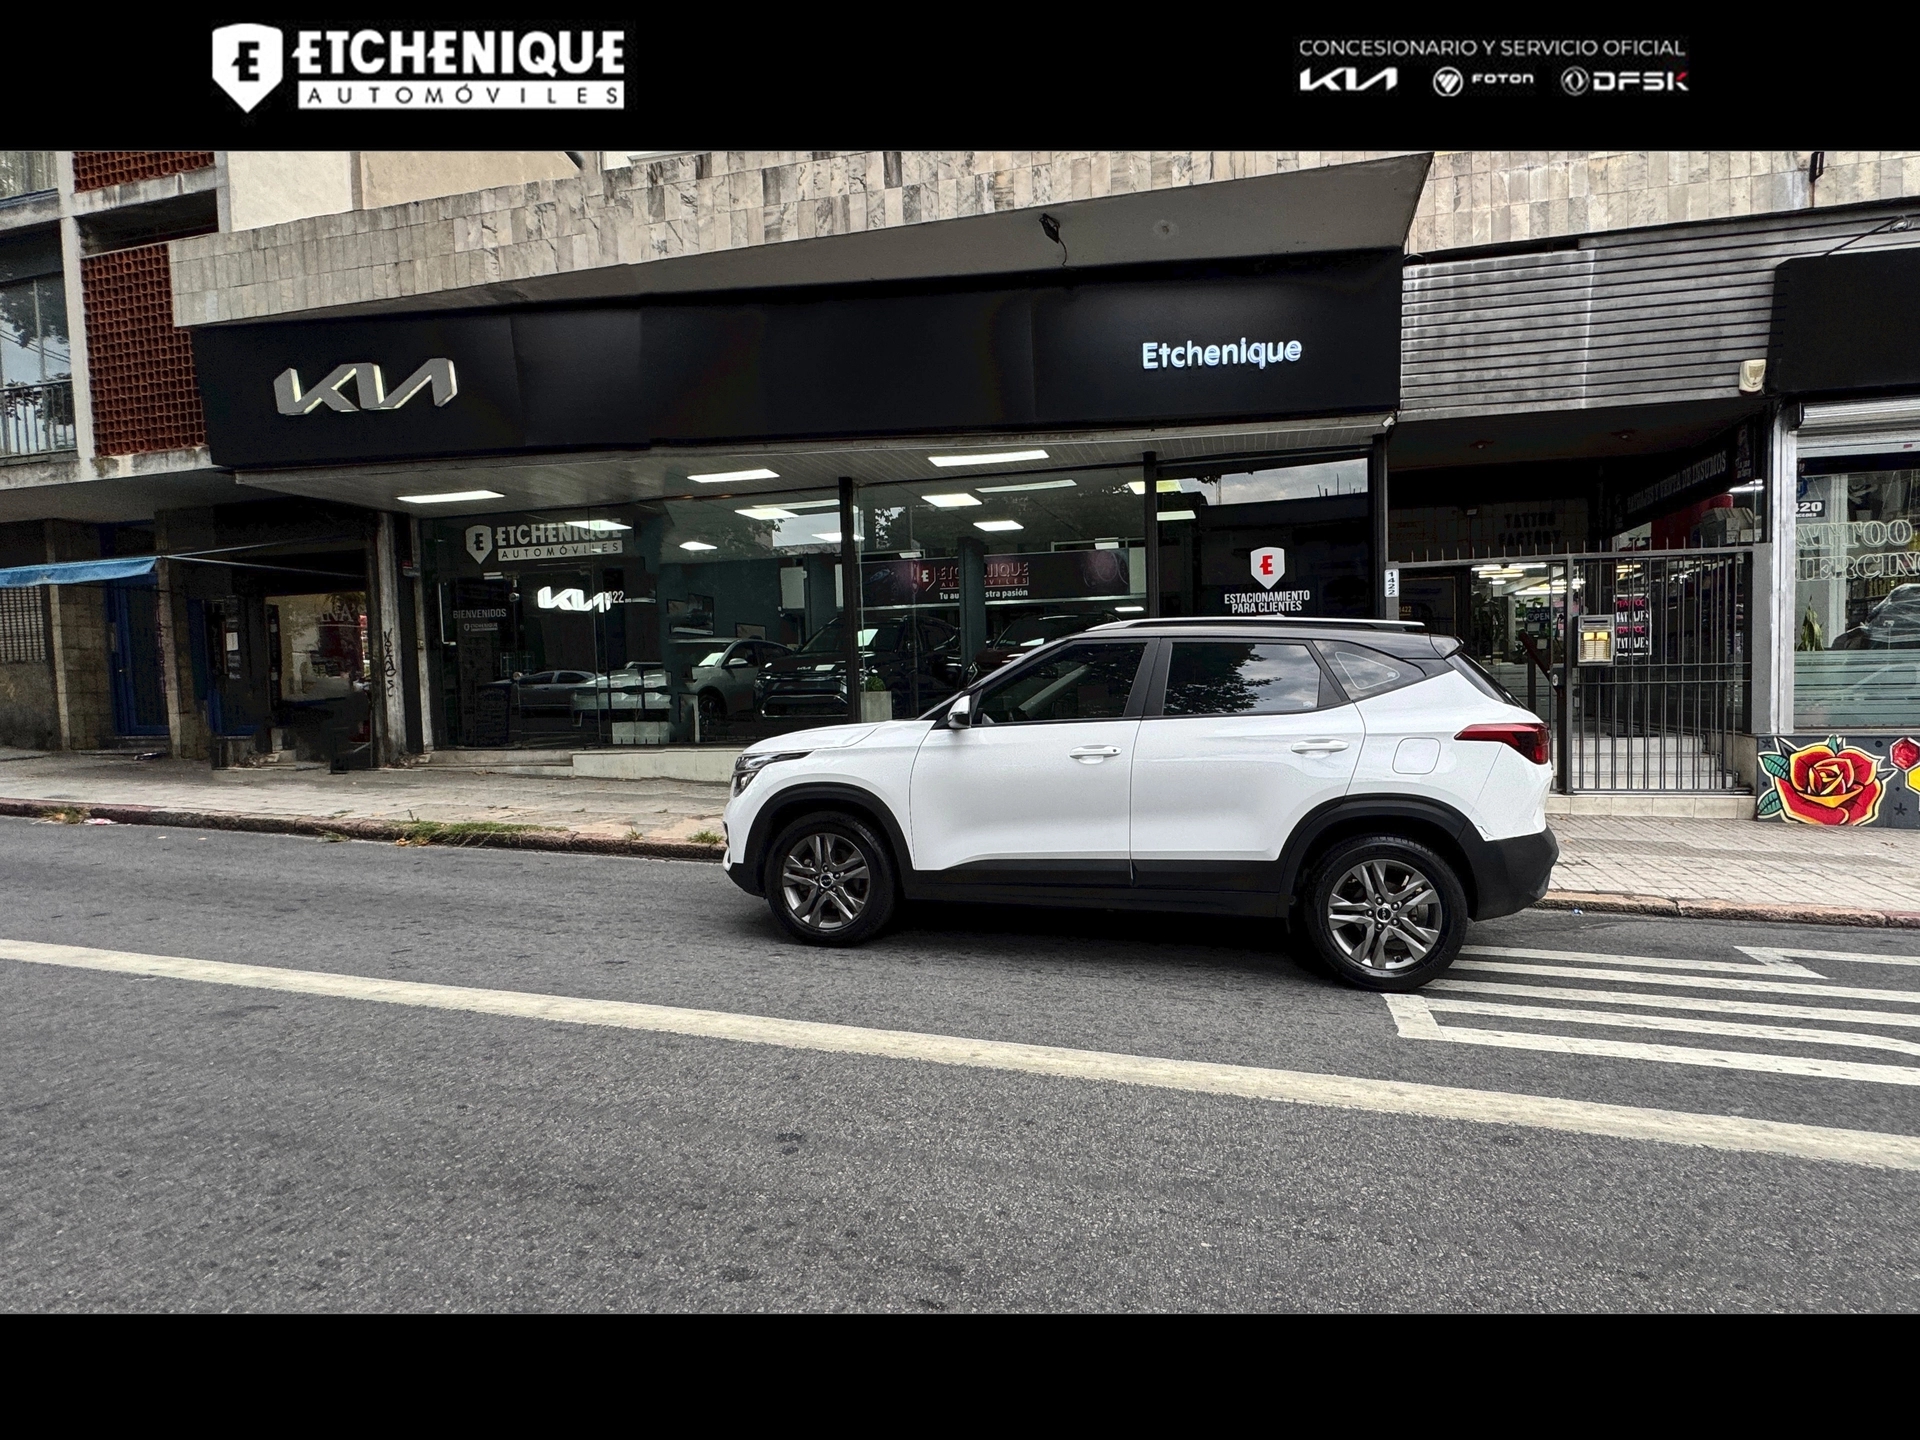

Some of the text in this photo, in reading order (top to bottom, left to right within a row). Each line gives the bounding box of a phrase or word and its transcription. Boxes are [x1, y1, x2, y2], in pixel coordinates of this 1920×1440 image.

[1142, 337, 1303, 370] Etchenique
[273, 357, 459, 416] KIA
[1387, 571, 1397, 596] 1422
[939, 592, 949, 600] Tu
[1001, 587, 1029, 599] pasión
[1224, 589, 1311, 604] ESTACIONAMIENTO
[452, 608, 507, 619] BIENVENIDOS
[1232, 600, 1303, 613] PARA CLIENTES
[1527, 611, 1551, 623] OPEN
